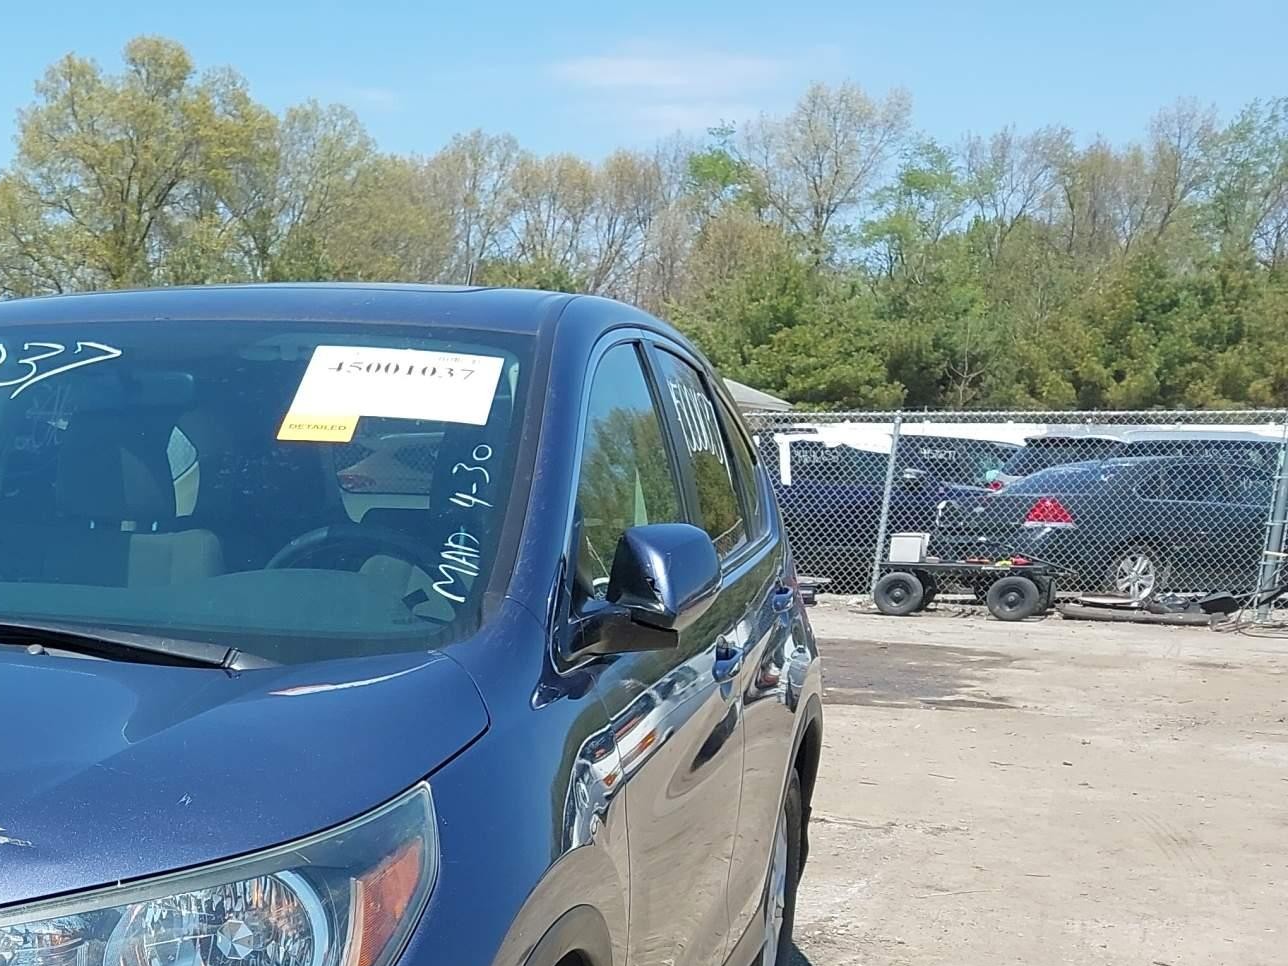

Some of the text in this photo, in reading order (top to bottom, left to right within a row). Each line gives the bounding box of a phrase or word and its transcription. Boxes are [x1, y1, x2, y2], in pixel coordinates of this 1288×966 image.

[327, 361, 475, 380] 45001037
[289, 423, 348, 431] DETAILED
[449, 443, 494, 508] 4-30
